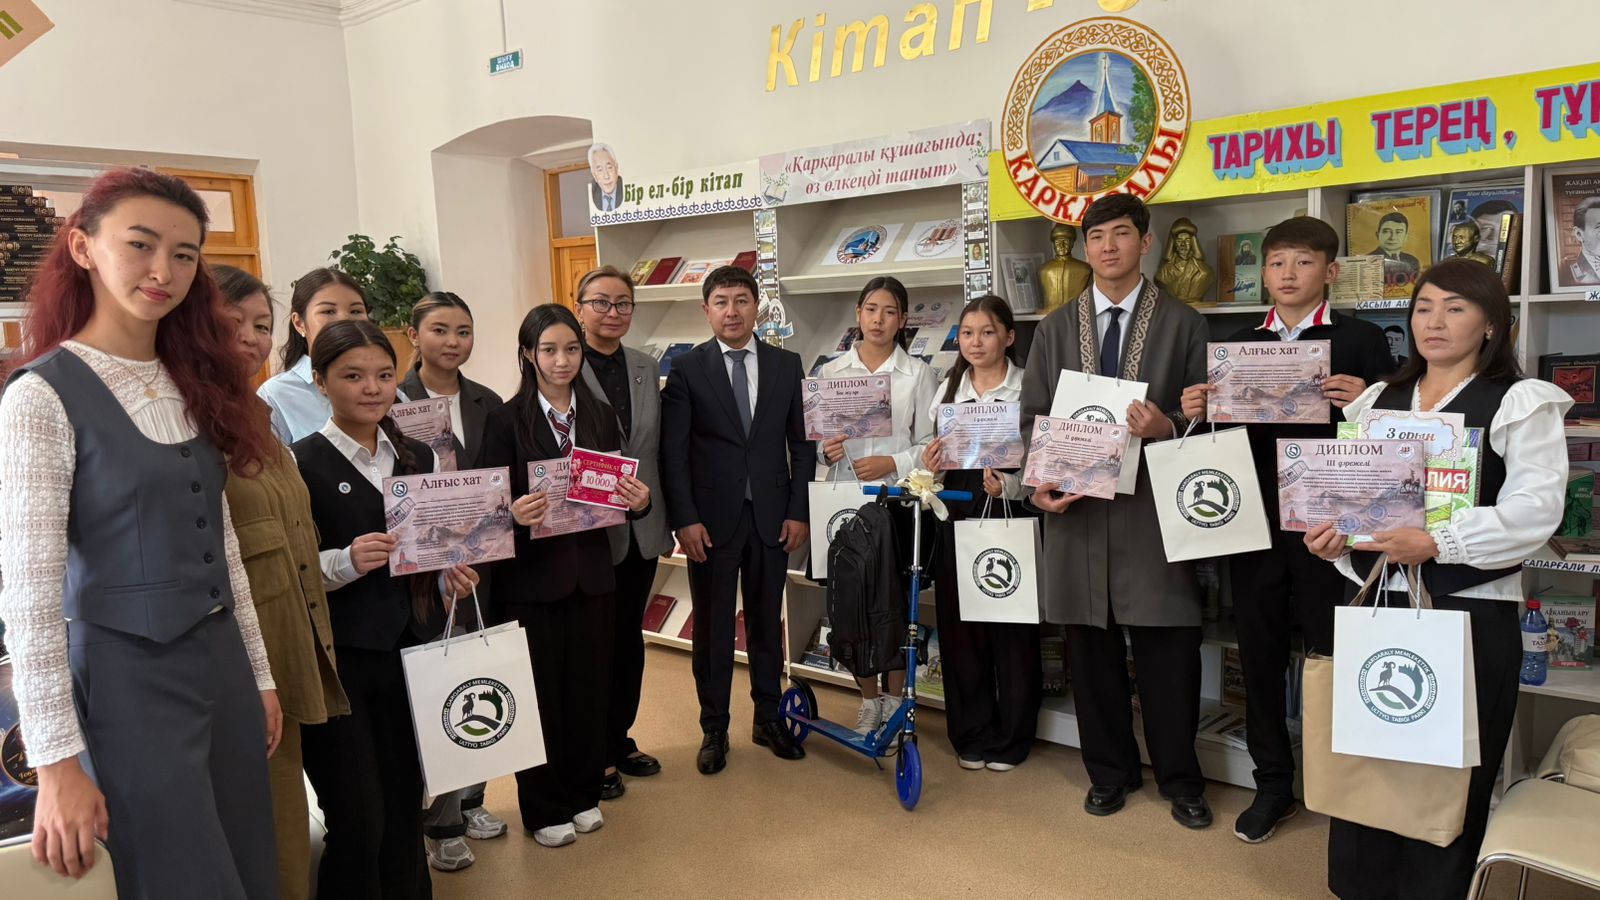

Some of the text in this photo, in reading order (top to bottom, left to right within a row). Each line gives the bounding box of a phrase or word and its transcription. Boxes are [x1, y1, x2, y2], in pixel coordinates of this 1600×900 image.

[1208, 119, 1340, 176] ТАРИХЫ
[1536, 81, 1600, 132] ТҰ
[624, 184, 644, 205] Бір
[700, 171, 744, 193] кітап
[806, 182, 820, 195] өз
[824, 168, 882, 190] өлкеңді
[1239, 346, 1300, 356] Алғыс хат
[827, 379, 868, 390] ДИПЛОМ
[390, 404, 431, 418] Алғыс хат
[963, 405, 1007, 415] ДИПЛОМ
[1059, 422, 1103, 435] ДИПЛОМ
[1386, 428, 1396, 438] 3
[1315, 444, 1383, 457] ДИПЛОМ
[582, 460, 620, 472] СЕРТИФИКАТ
[420, 476, 482, 489] Алғыс хат
[586, 475, 611, 488] 10 000
[1591, 565, 1600, 573] Л
